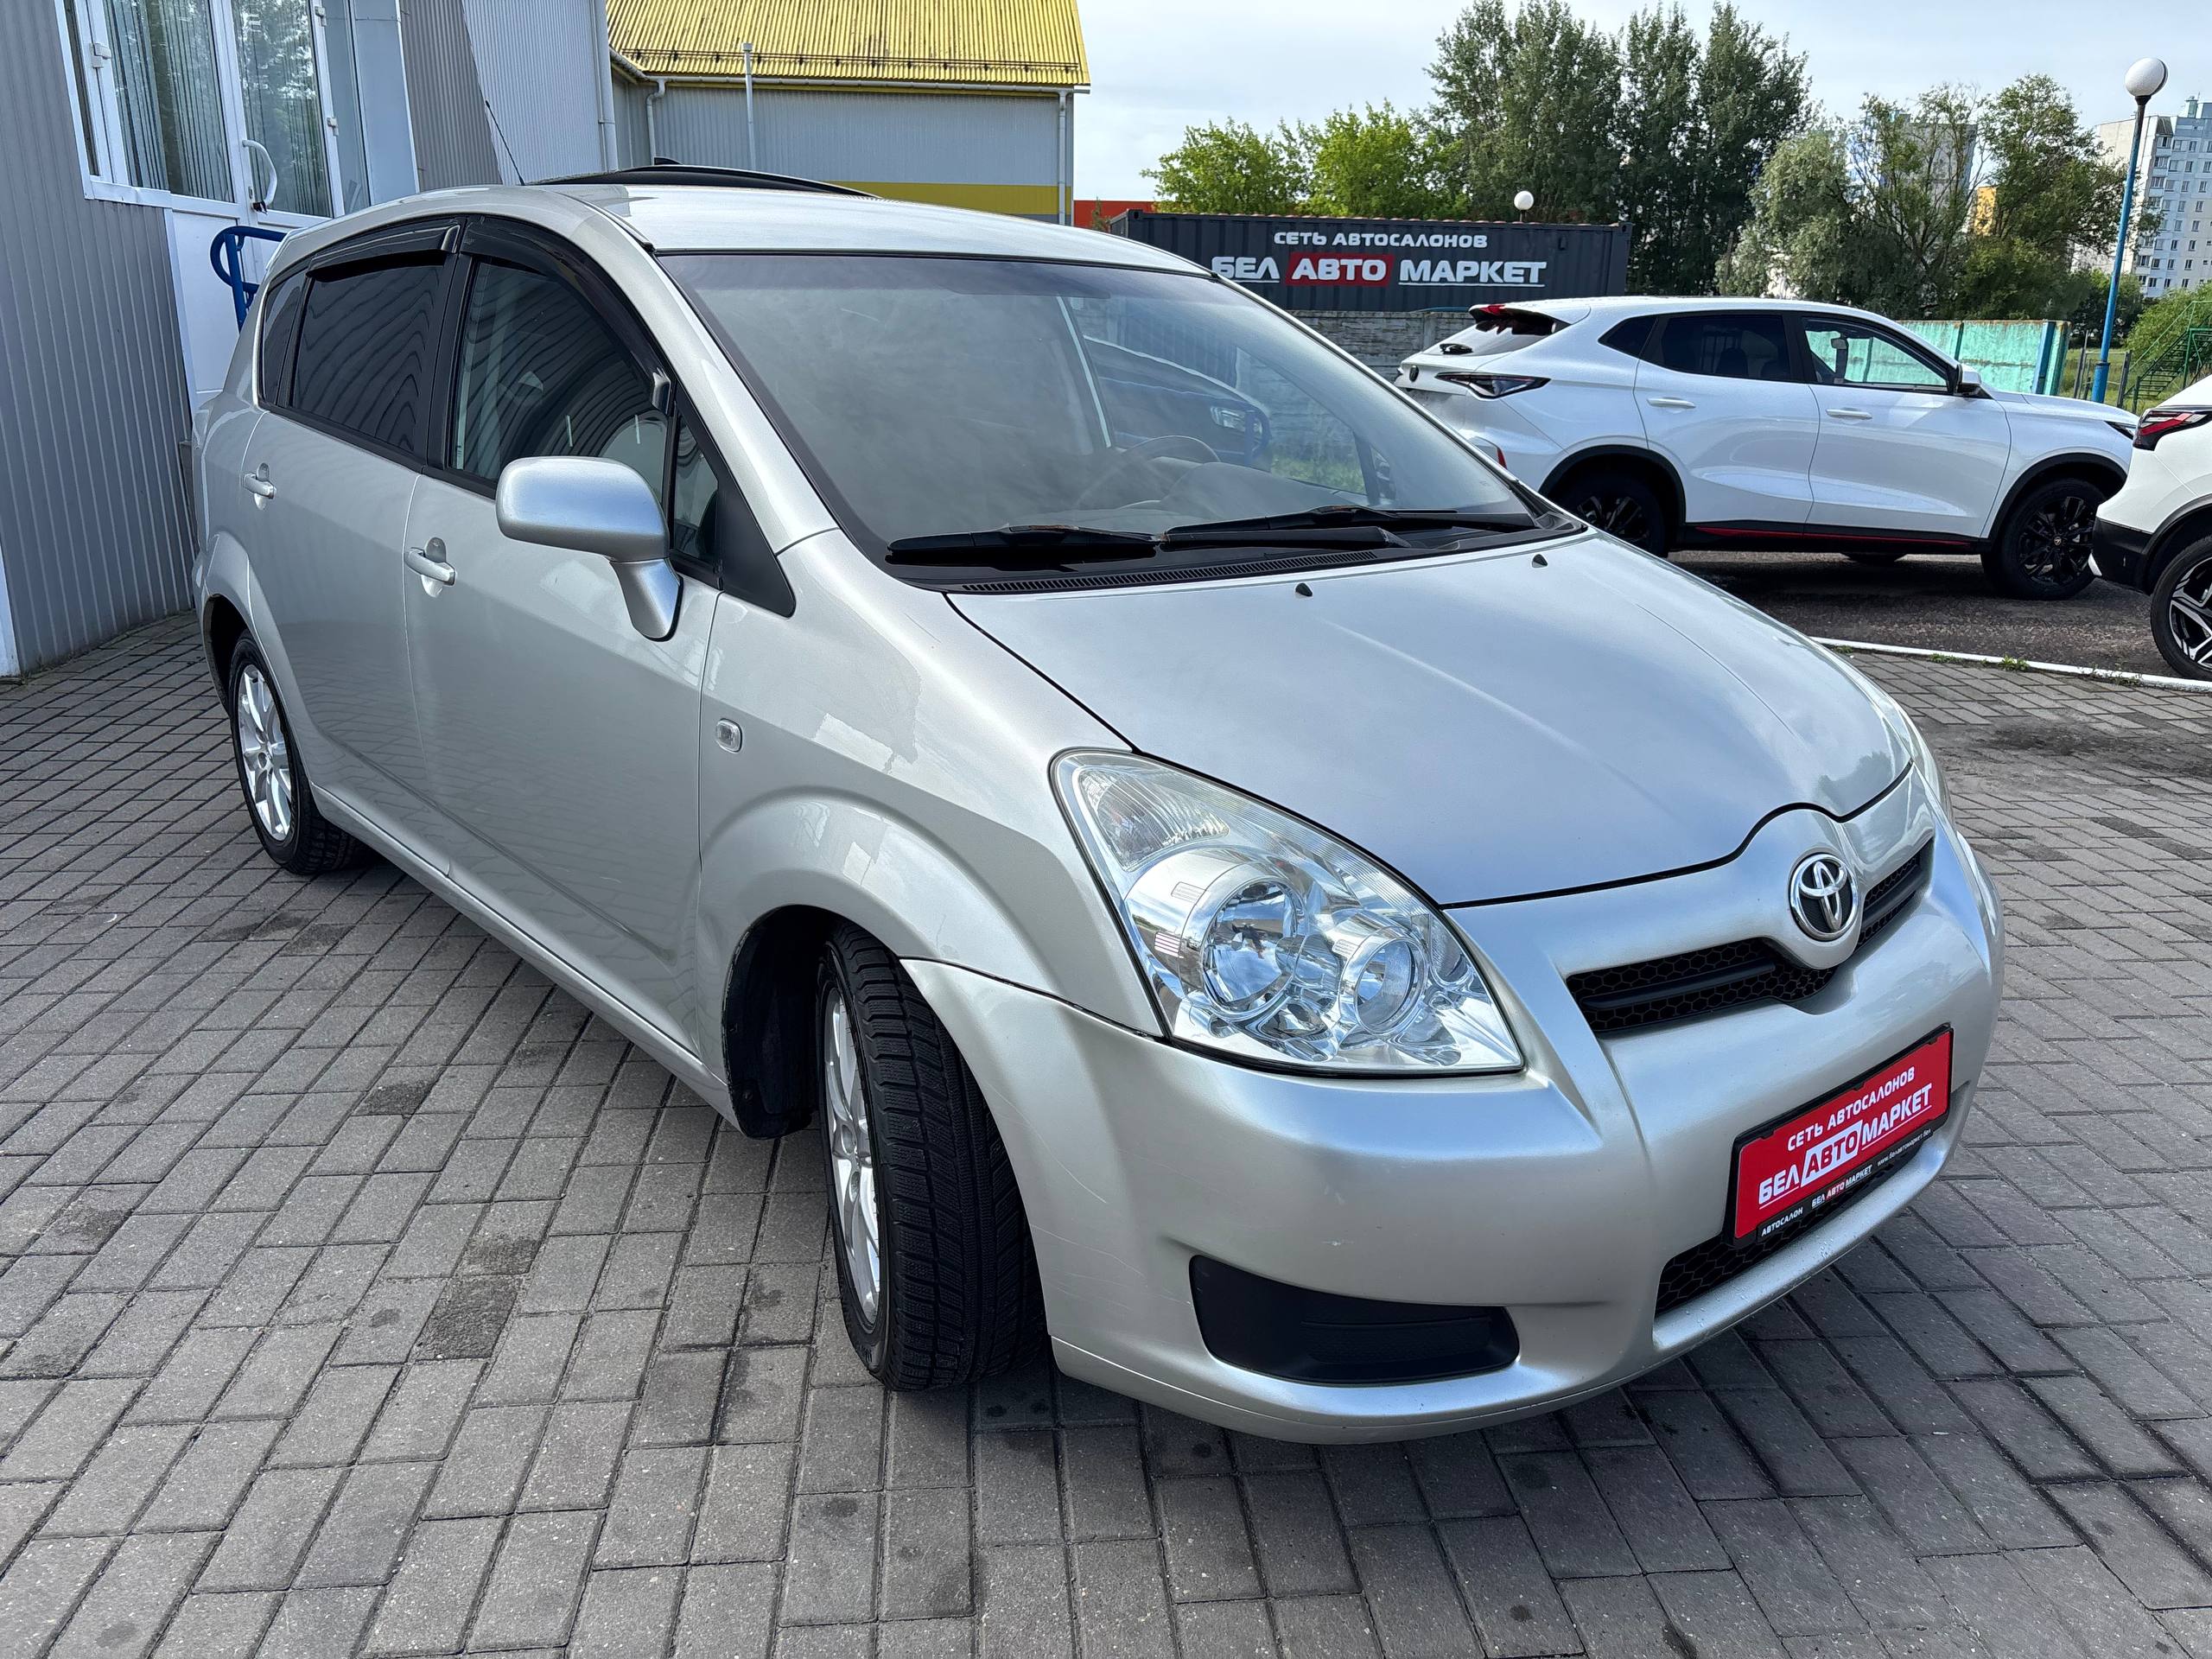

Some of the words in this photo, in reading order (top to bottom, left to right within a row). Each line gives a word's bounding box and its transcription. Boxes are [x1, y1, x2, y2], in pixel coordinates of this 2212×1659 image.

[1211, 256, 1281, 280] БЕЛ
[1291, 257, 1387, 282] АВТО
[1400, 259, 1547, 283] МАРКЕТ
[1274, 232, 1327, 246] СЕТЬ
[1332, 232, 1488, 248] АВТОСАЛОНОВ
[1758, 1164, 1800, 1205] БЕЛ
[1805, 1129, 1859, 1179] АВТО
[1861, 1083, 1932, 1147] МАРКЕТ
[1787, 1122, 1823, 1152] СЕТЬ
[1827, 1066, 1915, 1131] АВТОСАЛОНОВ
[1761, 1206, 1803, 1236] АВТОСАЛОН
[1811, 1193, 1825, 1208] БЕЛ
[1826, 1181, 1845, 1199] АВТО
[1845, 1165, 1872, 1188] МАРКЕТ
